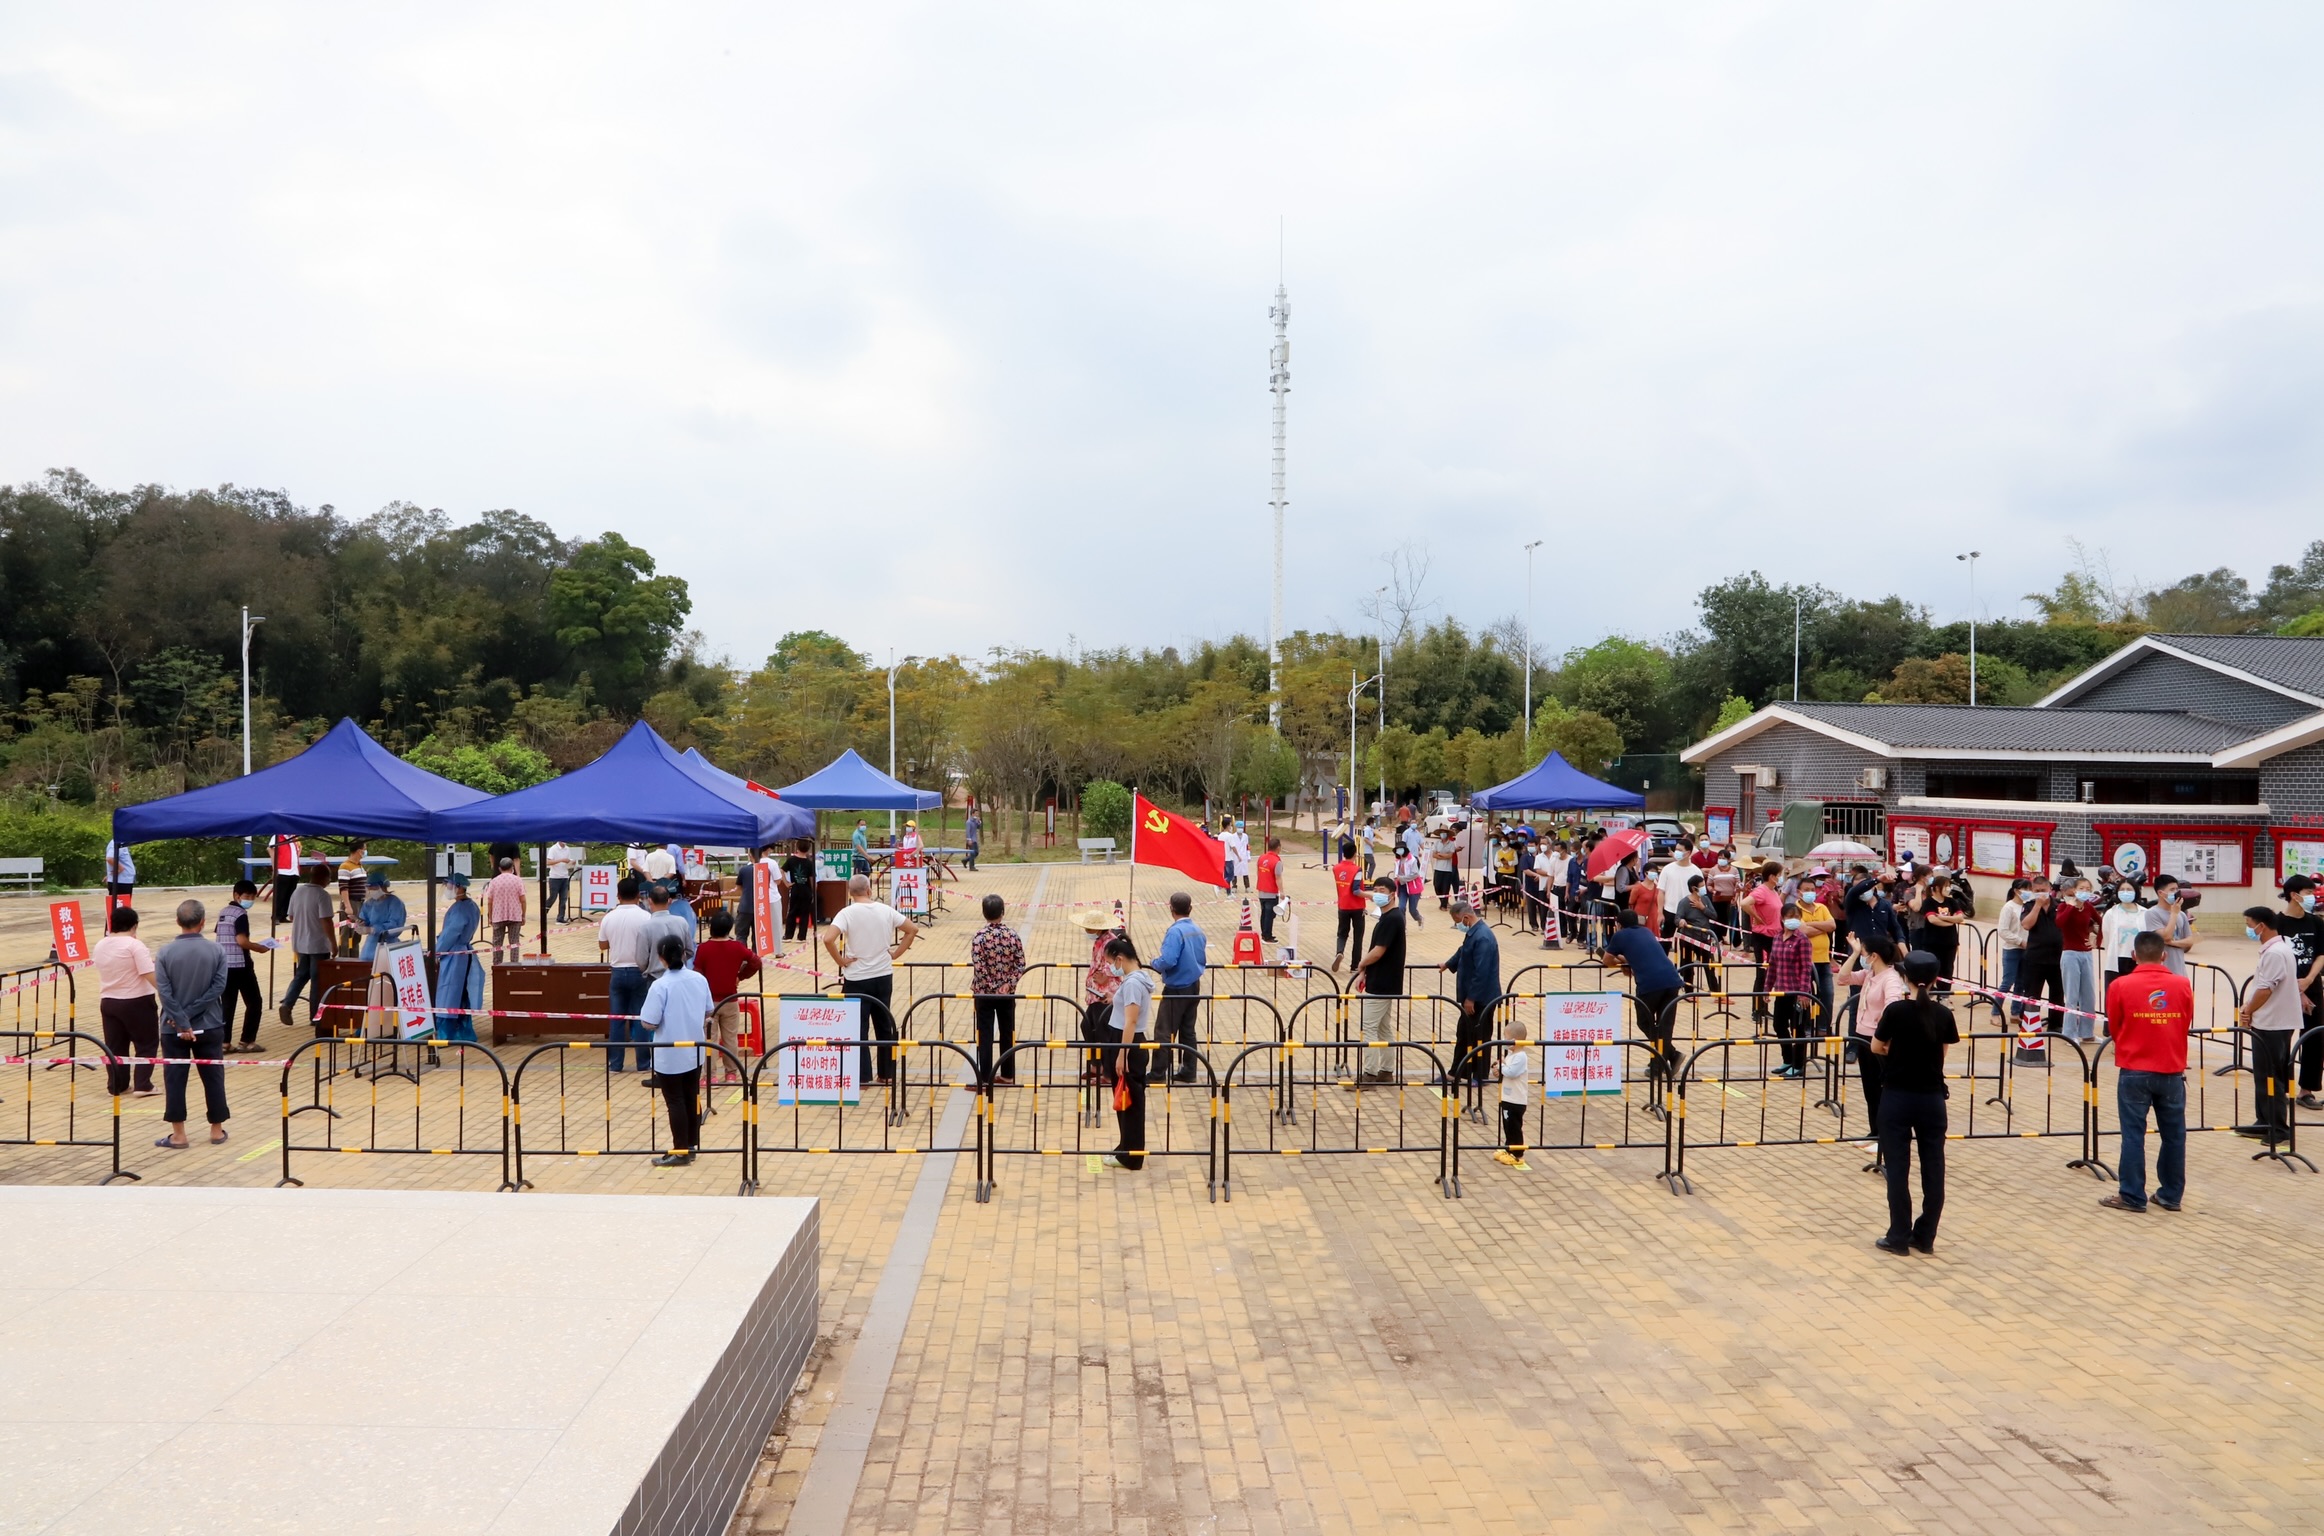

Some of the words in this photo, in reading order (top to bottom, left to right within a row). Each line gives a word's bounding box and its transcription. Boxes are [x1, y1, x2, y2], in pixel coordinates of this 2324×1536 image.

[590, 870, 609, 905] 出口
[900, 874, 919, 908] 出口
[757, 870, 768, 950] 信息录入区
[59, 906, 80, 958] 救护区
[398, 953, 416, 980] 核酸
[400, 982, 425, 1008] 采样点
[796, 1007, 847, 1023] 温馨提示
[1561, 1001, 1609, 1015] 温馨提示
[1553, 1028, 1614, 1041] 接种新冠疫苗后
[800, 1056, 838, 1071] 48小时内
[1553, 1065, 1614, 1081] 不可做核酸采样
[787, 1074, 852, 1090] 不可做核酸采样
